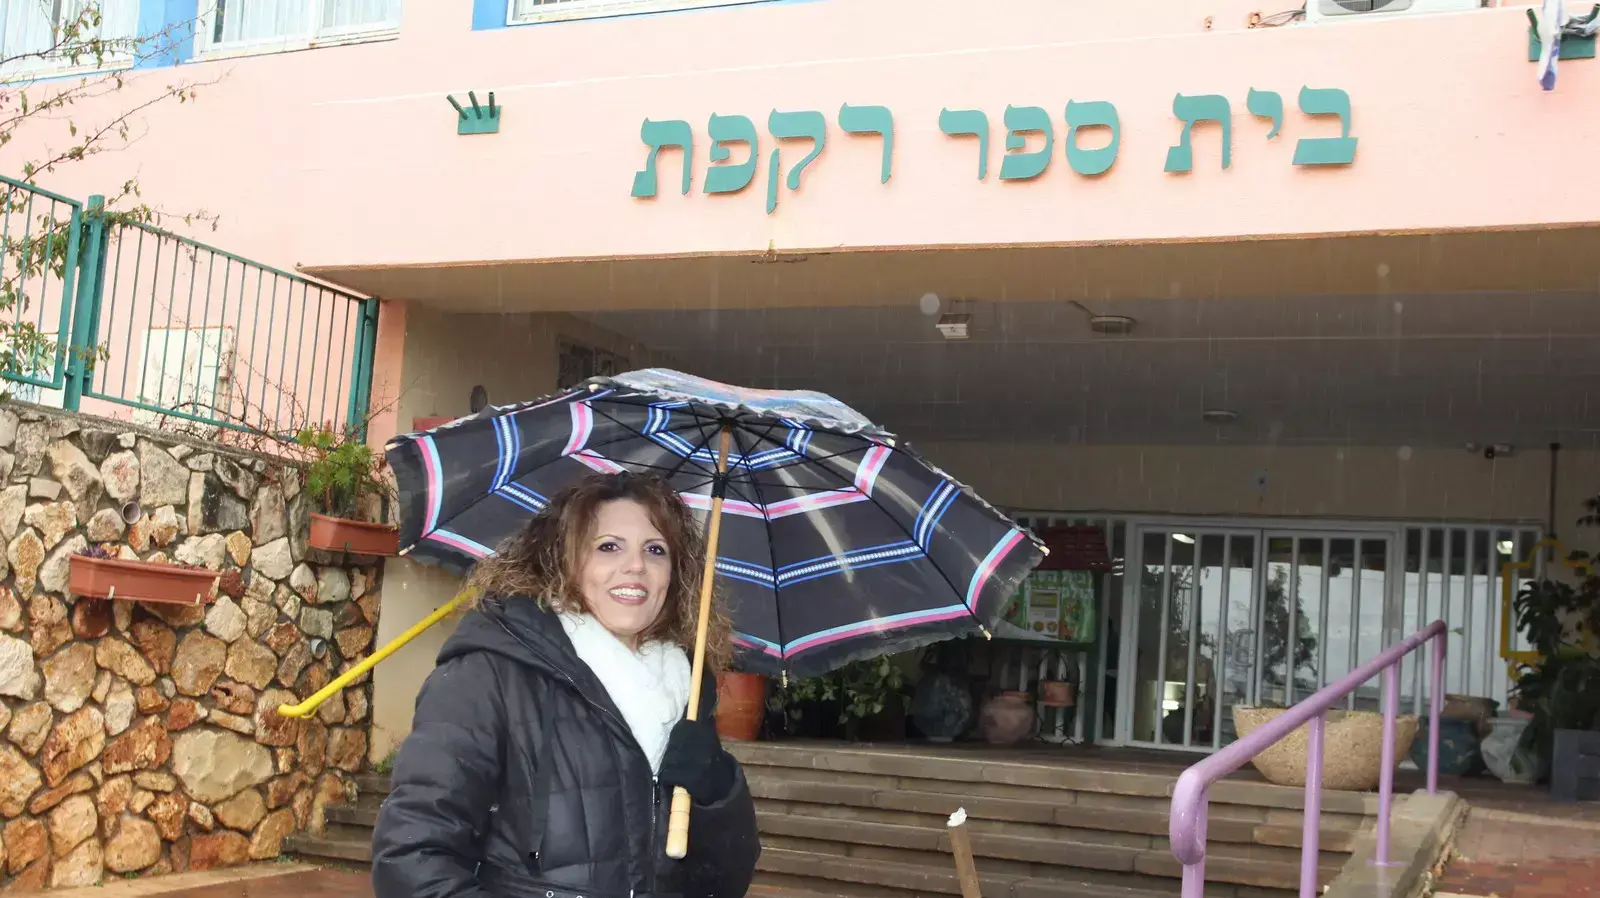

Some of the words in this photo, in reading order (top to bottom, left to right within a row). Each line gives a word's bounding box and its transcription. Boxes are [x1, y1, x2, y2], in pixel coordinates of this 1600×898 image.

[631, 102, 893, 214] רקפת
[938, 98, 1121, 177] ספר
[1164, 84, 1359, 174] בית
